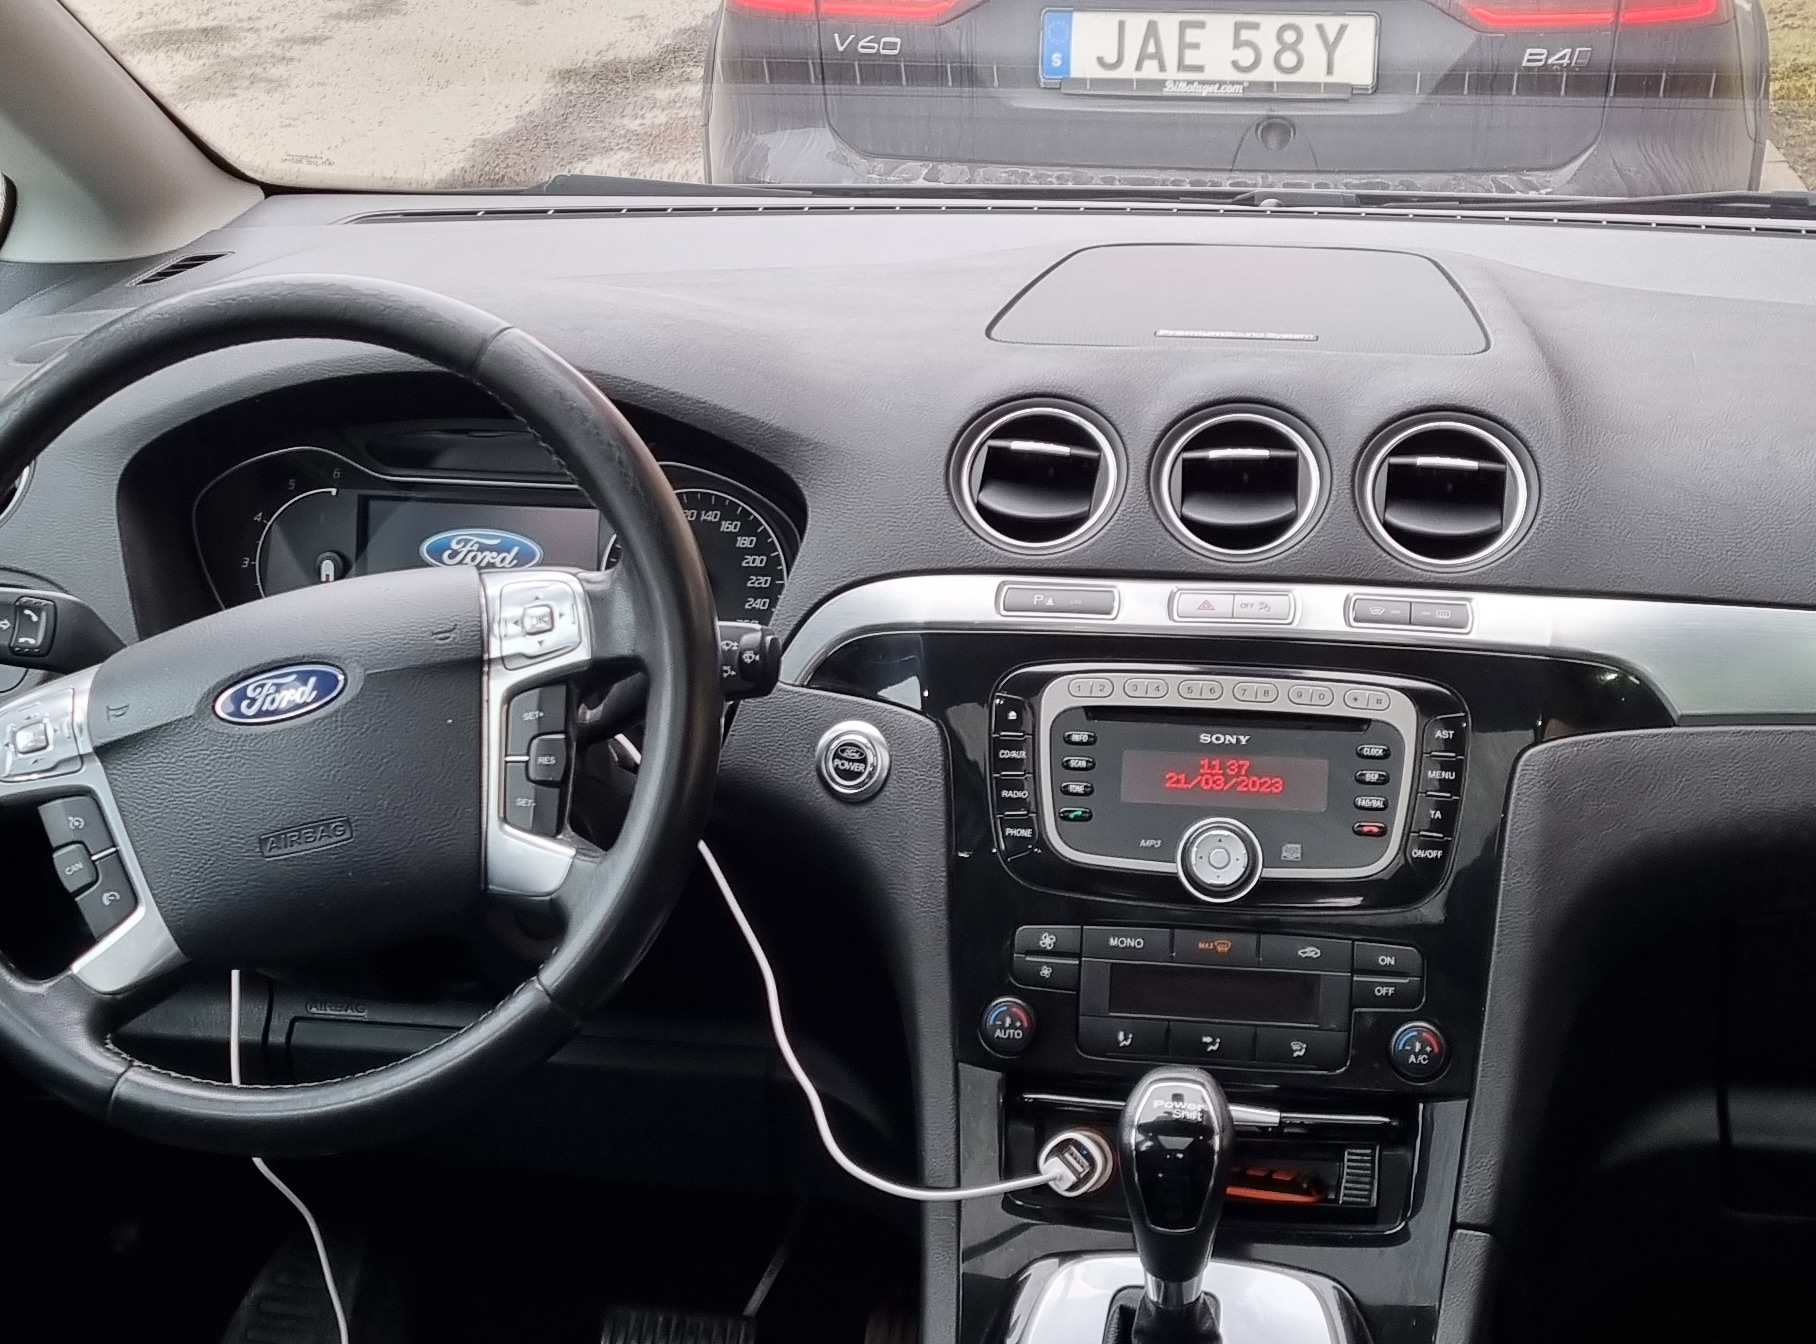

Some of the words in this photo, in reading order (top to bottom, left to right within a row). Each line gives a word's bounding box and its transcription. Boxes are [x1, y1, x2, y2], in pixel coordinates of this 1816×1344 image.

[834, 33, 901, 55] V60
[1096, 19, 1206, 73] JAE
[1231, 21, 1349, 76] 58Y
[1051, 53, 1062, 67] S
[332, 468, 342, 479] 6
[287, 479, 296, 490] 5
[253, 511, 263, 522] 4
[700, 510, 720, 522] 140
[720, 521, 740, 532] 160
[735, 536, 756, 548] 180
[442, 536, 519, 568] Ford
[241, 557, 250, 568] 3
[742, 556, 767, 567] 200
[746, 576, 771, 587] 220
[744, 598, 770, 609] 240
[241, 674, 317, 716] Ford
[1132, 684, 1138, 692] 3
[1154, 684, 1160, 692] 4
[1187, 686, 1193, 694] 5
[1209, 686, 1216, 695] 6
[1241, 688, 1247, 697] 7
[1199, 733, 1250, 745] SONY
[1435, 730, 1454, 739] AST
[537, 756, 556, 765] RES
[833, 758, 865, 772] POWER
[1427, 770, 1456, 779] MENU
[1165, 771, 1284, 794] 21/03/2023
[1001, 789, 1028, 799] RADIO
[1430, 810, 1442, 819] TA
[267, 822, 347, 853] AIRBAG
[1005, 828, 1032, 837] PHONE
[1139, 839, 1162, 848] MP3
[1412, 849, 1443, 859] ON/OFF
[64, 861, 83, 875] CAN
[1109, 936, 1144, 949] MONO
[1198, 941, 1214, 950] MAX
[1378, 955, 1395, 965] ON
[1374, 986, 1395, 996] OFF
[994, 1029, 1023, 1039] AUTO
[1408, 1055, 1428, 1064] A/C
[1153, 1100, 1205, 1111] Power
[1172, 1108, 1203, 1122] Shift
